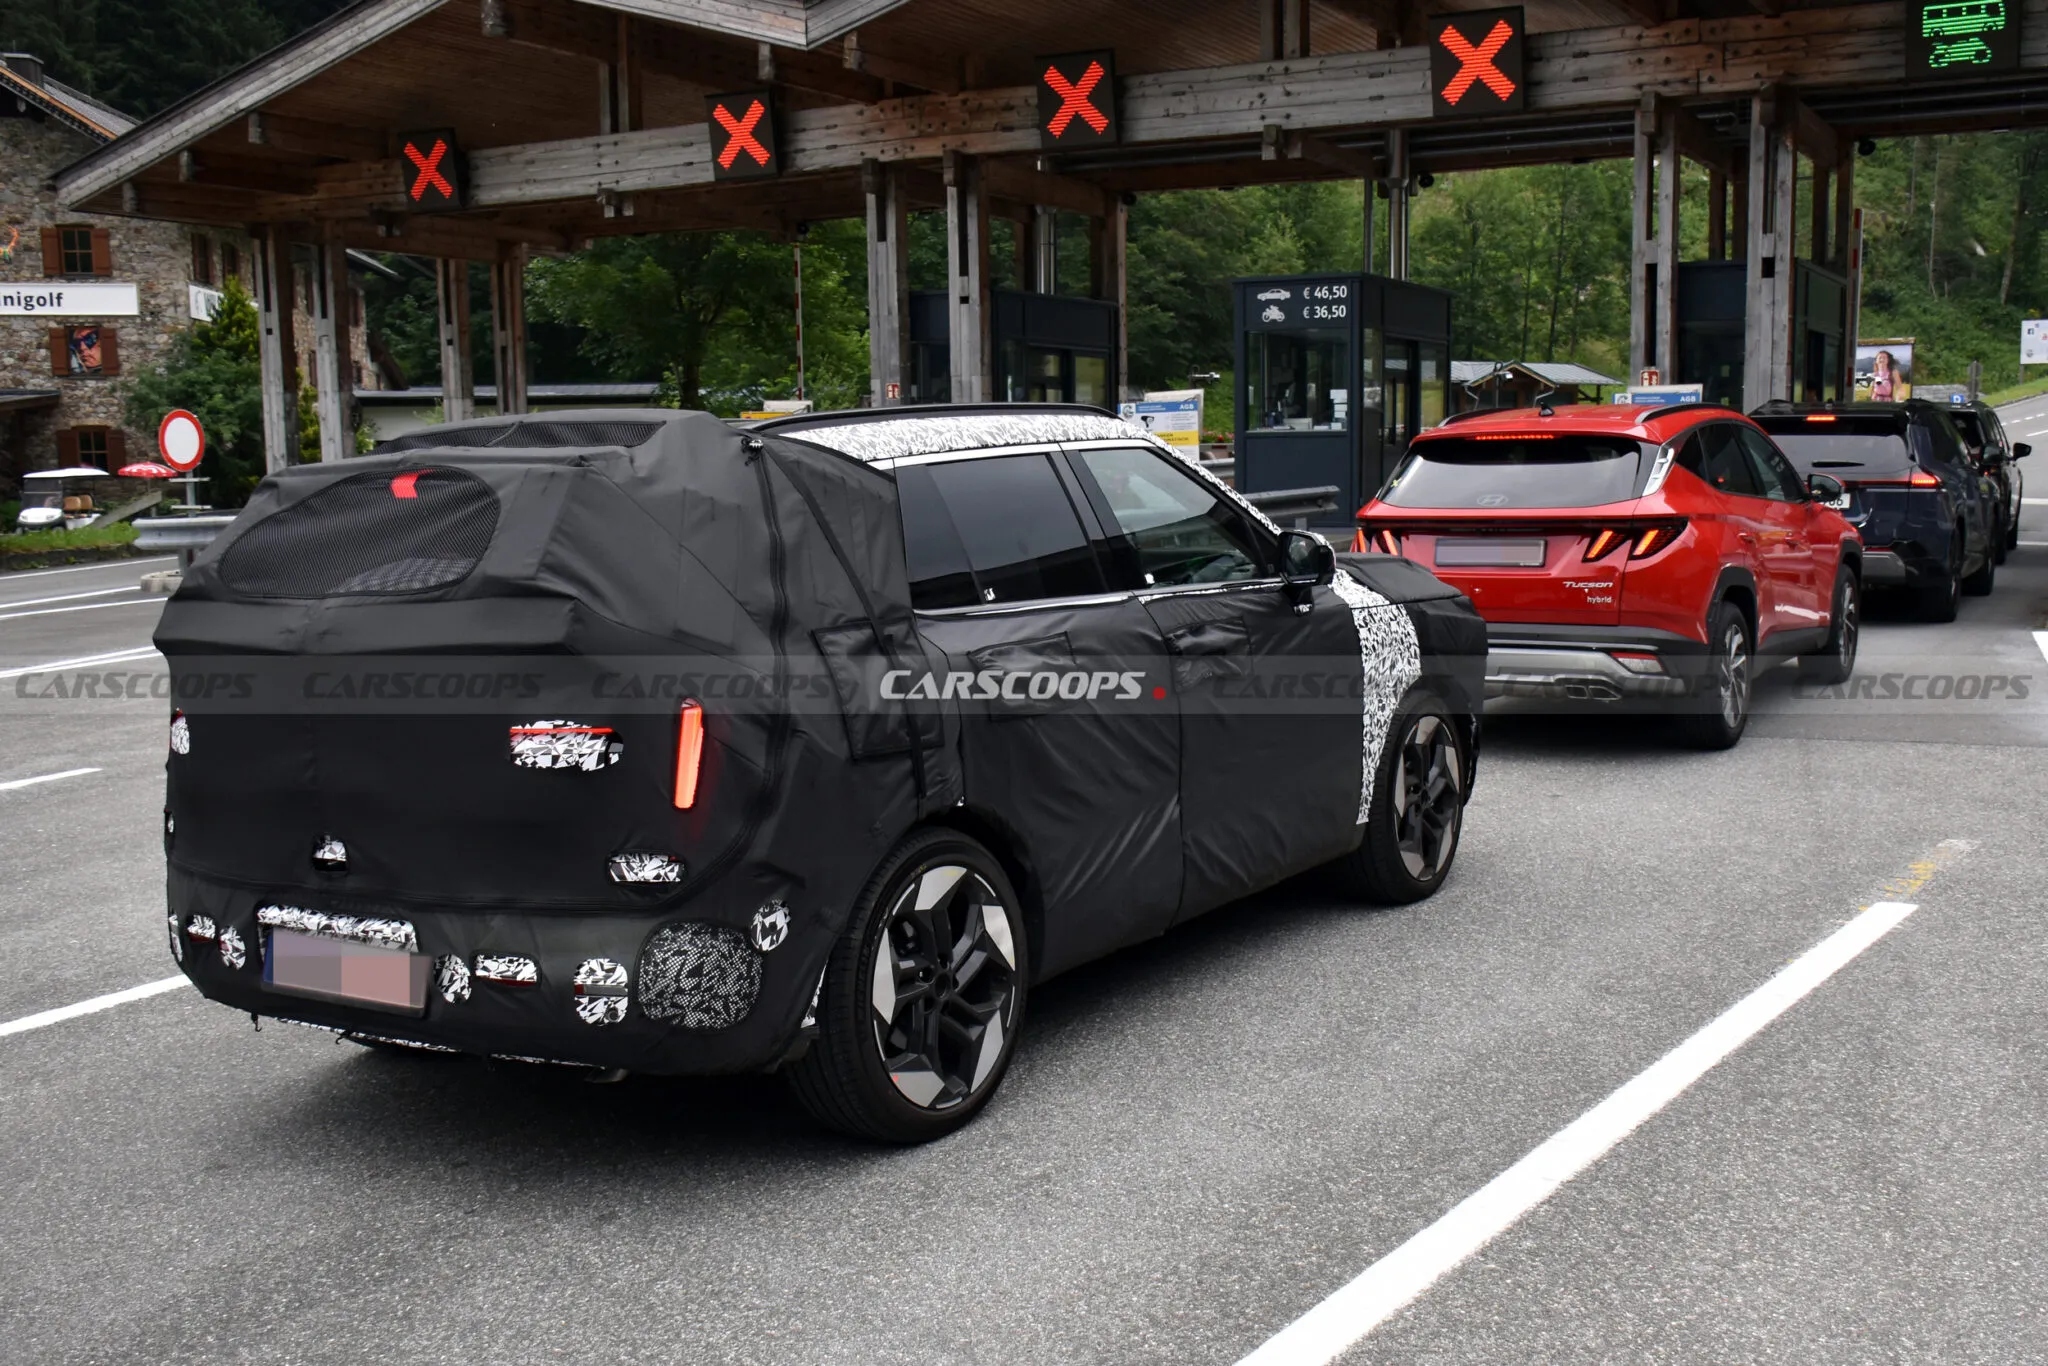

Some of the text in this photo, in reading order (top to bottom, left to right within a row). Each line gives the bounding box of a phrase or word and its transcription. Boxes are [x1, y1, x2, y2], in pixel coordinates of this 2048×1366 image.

[1303, 285, 1348, 300] € 46,50
[0, 291, 63, 311] nigolf
[1302, 305, 1347, 320] € 36,50
[1587, 596, 1612, 604] hybrid
